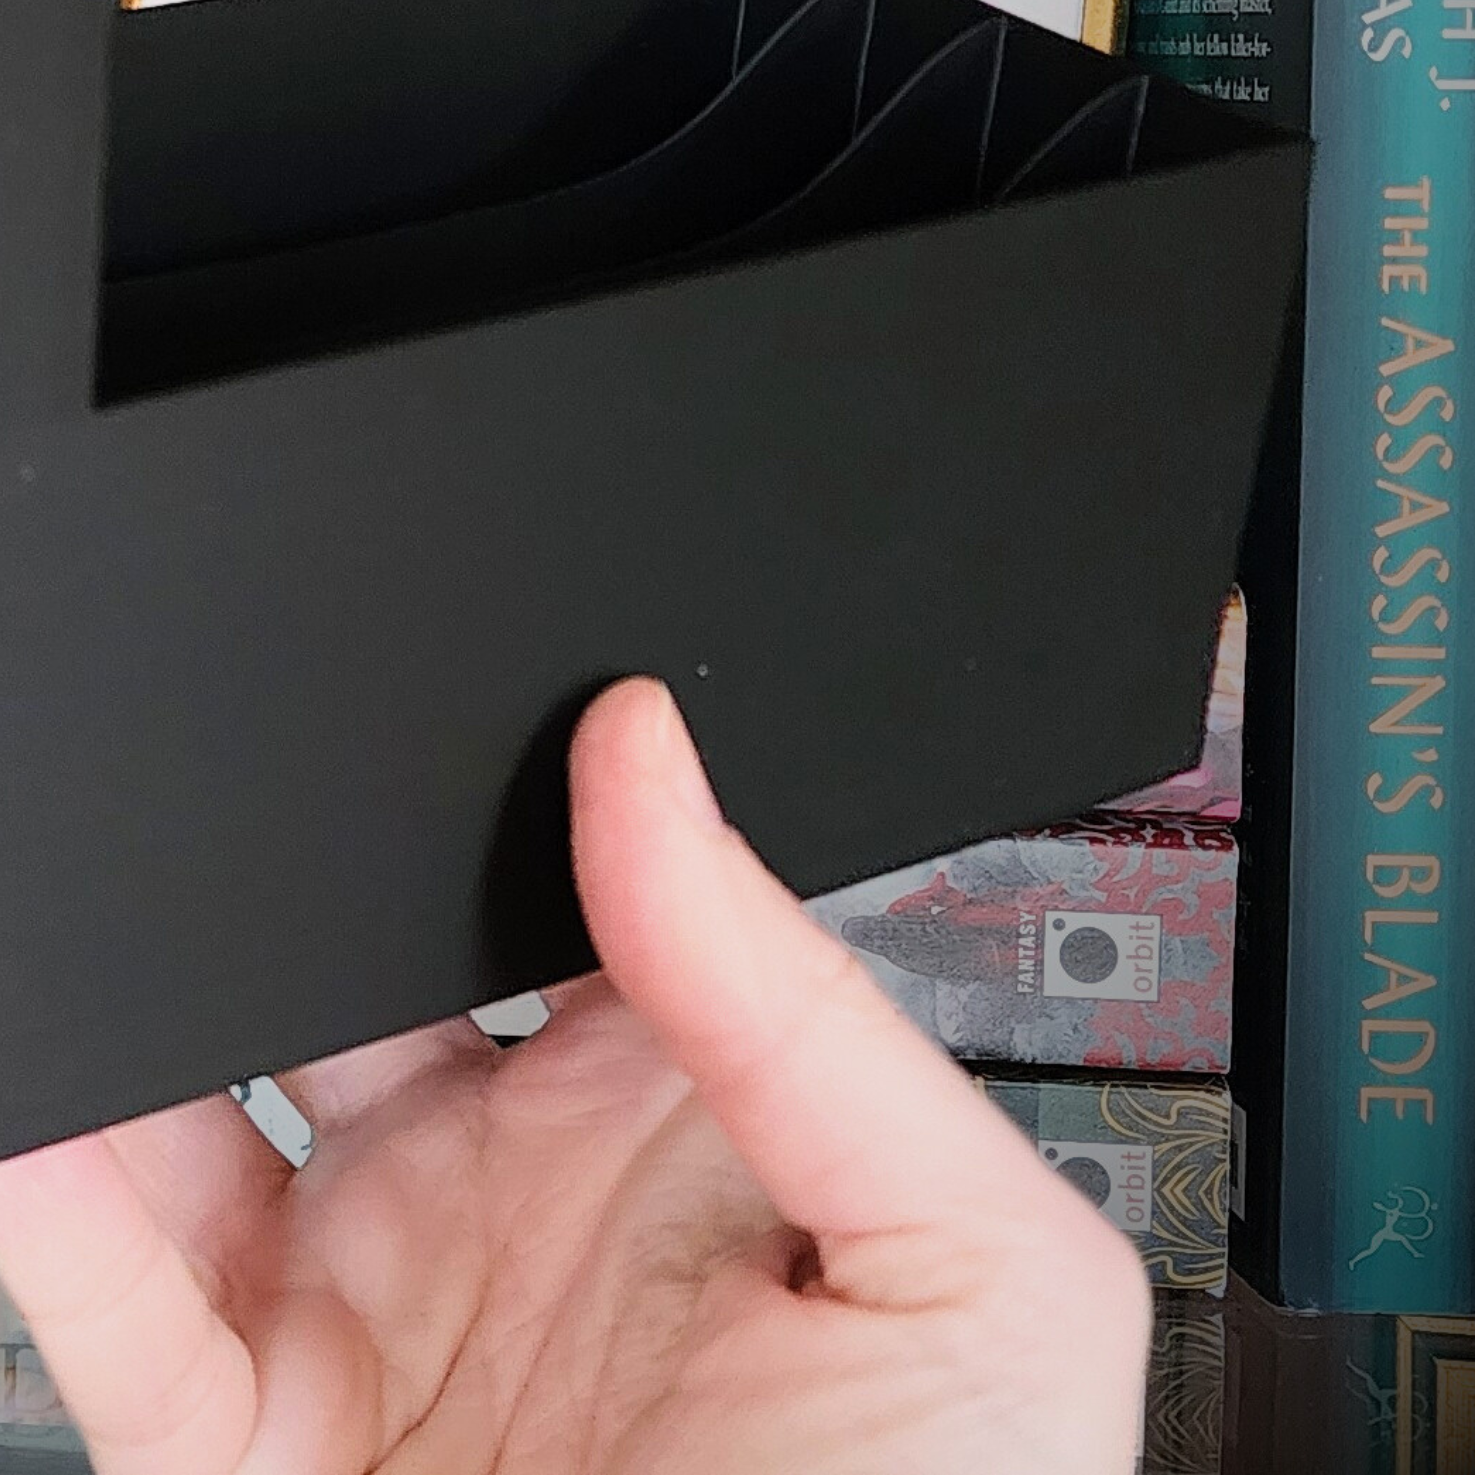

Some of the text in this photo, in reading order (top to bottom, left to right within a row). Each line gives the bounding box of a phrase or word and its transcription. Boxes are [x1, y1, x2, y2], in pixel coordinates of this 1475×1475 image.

[1359, 175, 1455, 1125] THE ASSASSIN'S BLADE
[1017, 911, 1036, 994] FANTASY
[1126, 921, 1155, 993] orbit
[1118, 1150, 1147, 1223] orbit
